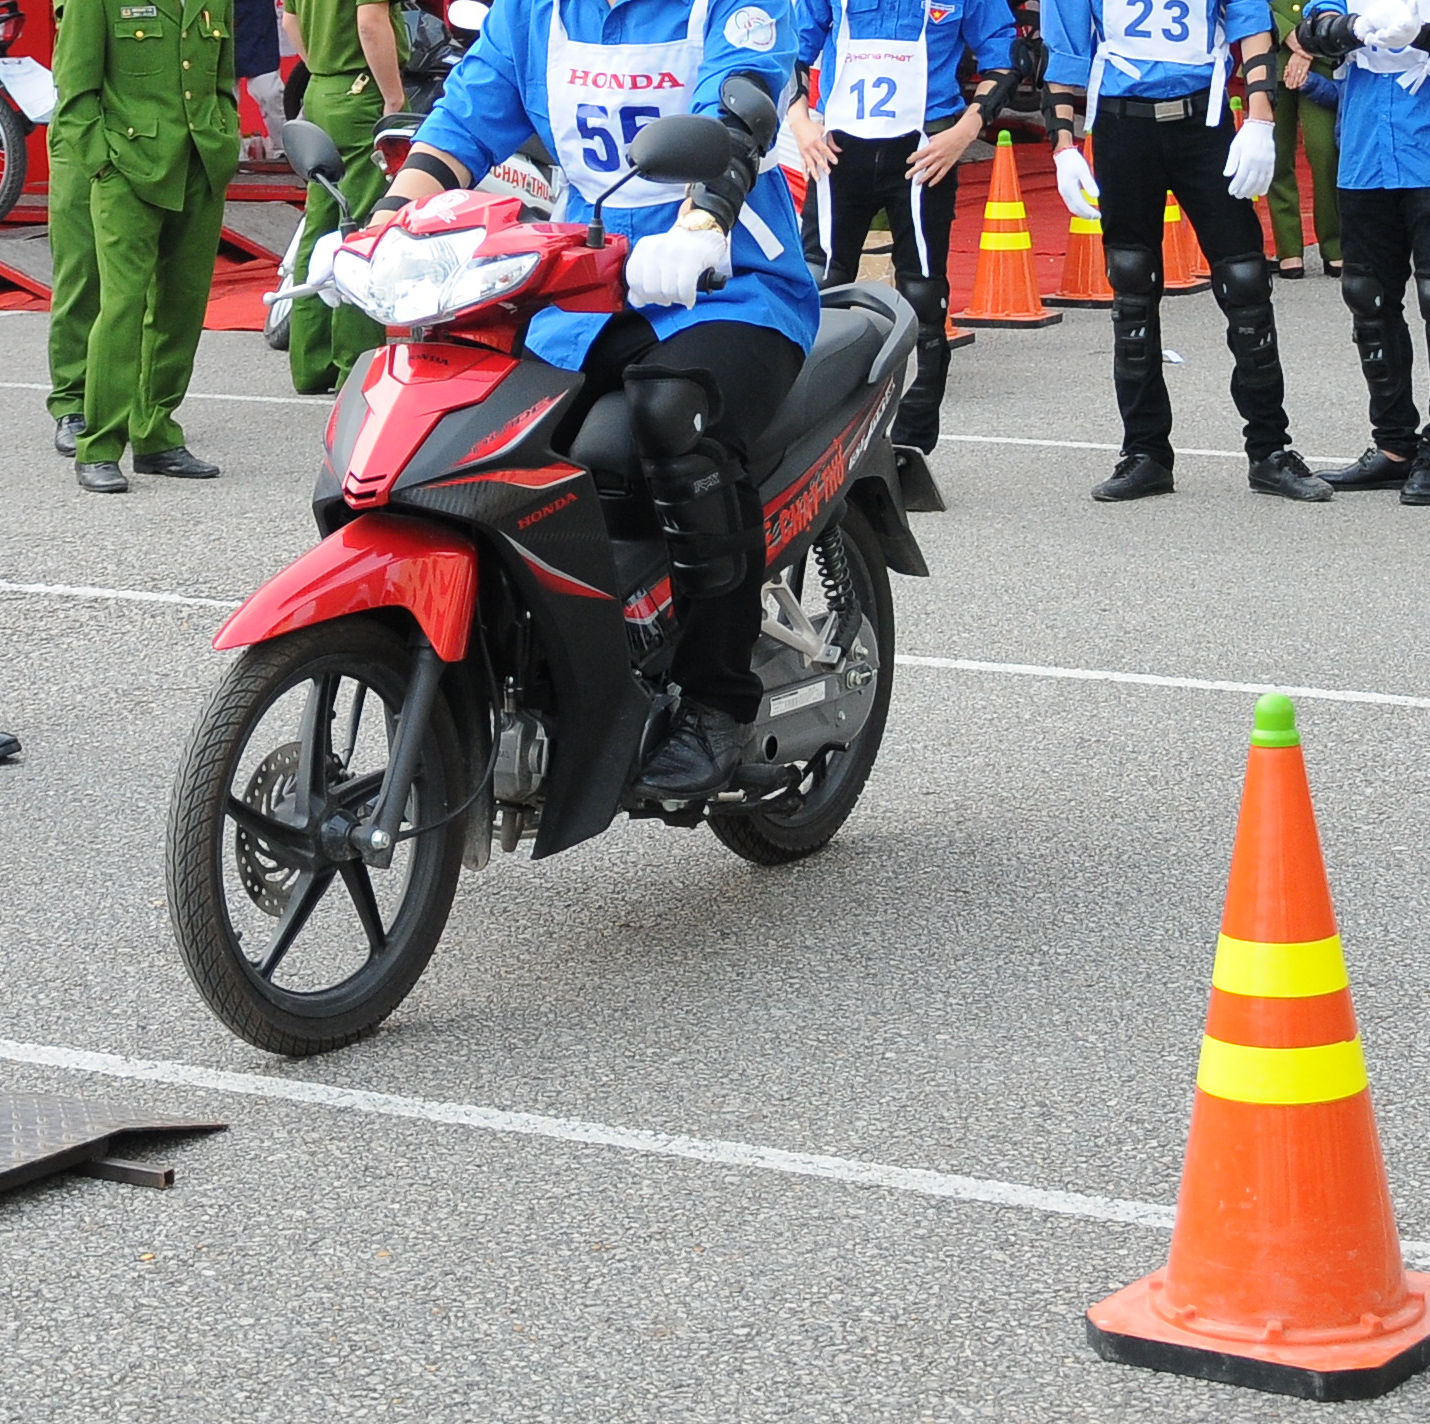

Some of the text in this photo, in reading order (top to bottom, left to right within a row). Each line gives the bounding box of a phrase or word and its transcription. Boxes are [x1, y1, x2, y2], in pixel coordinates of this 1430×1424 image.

[568, 68, 685, 91] HONDA
[849, 76, 897, 120] 12
[517, 492, 578, 531] HONDA
